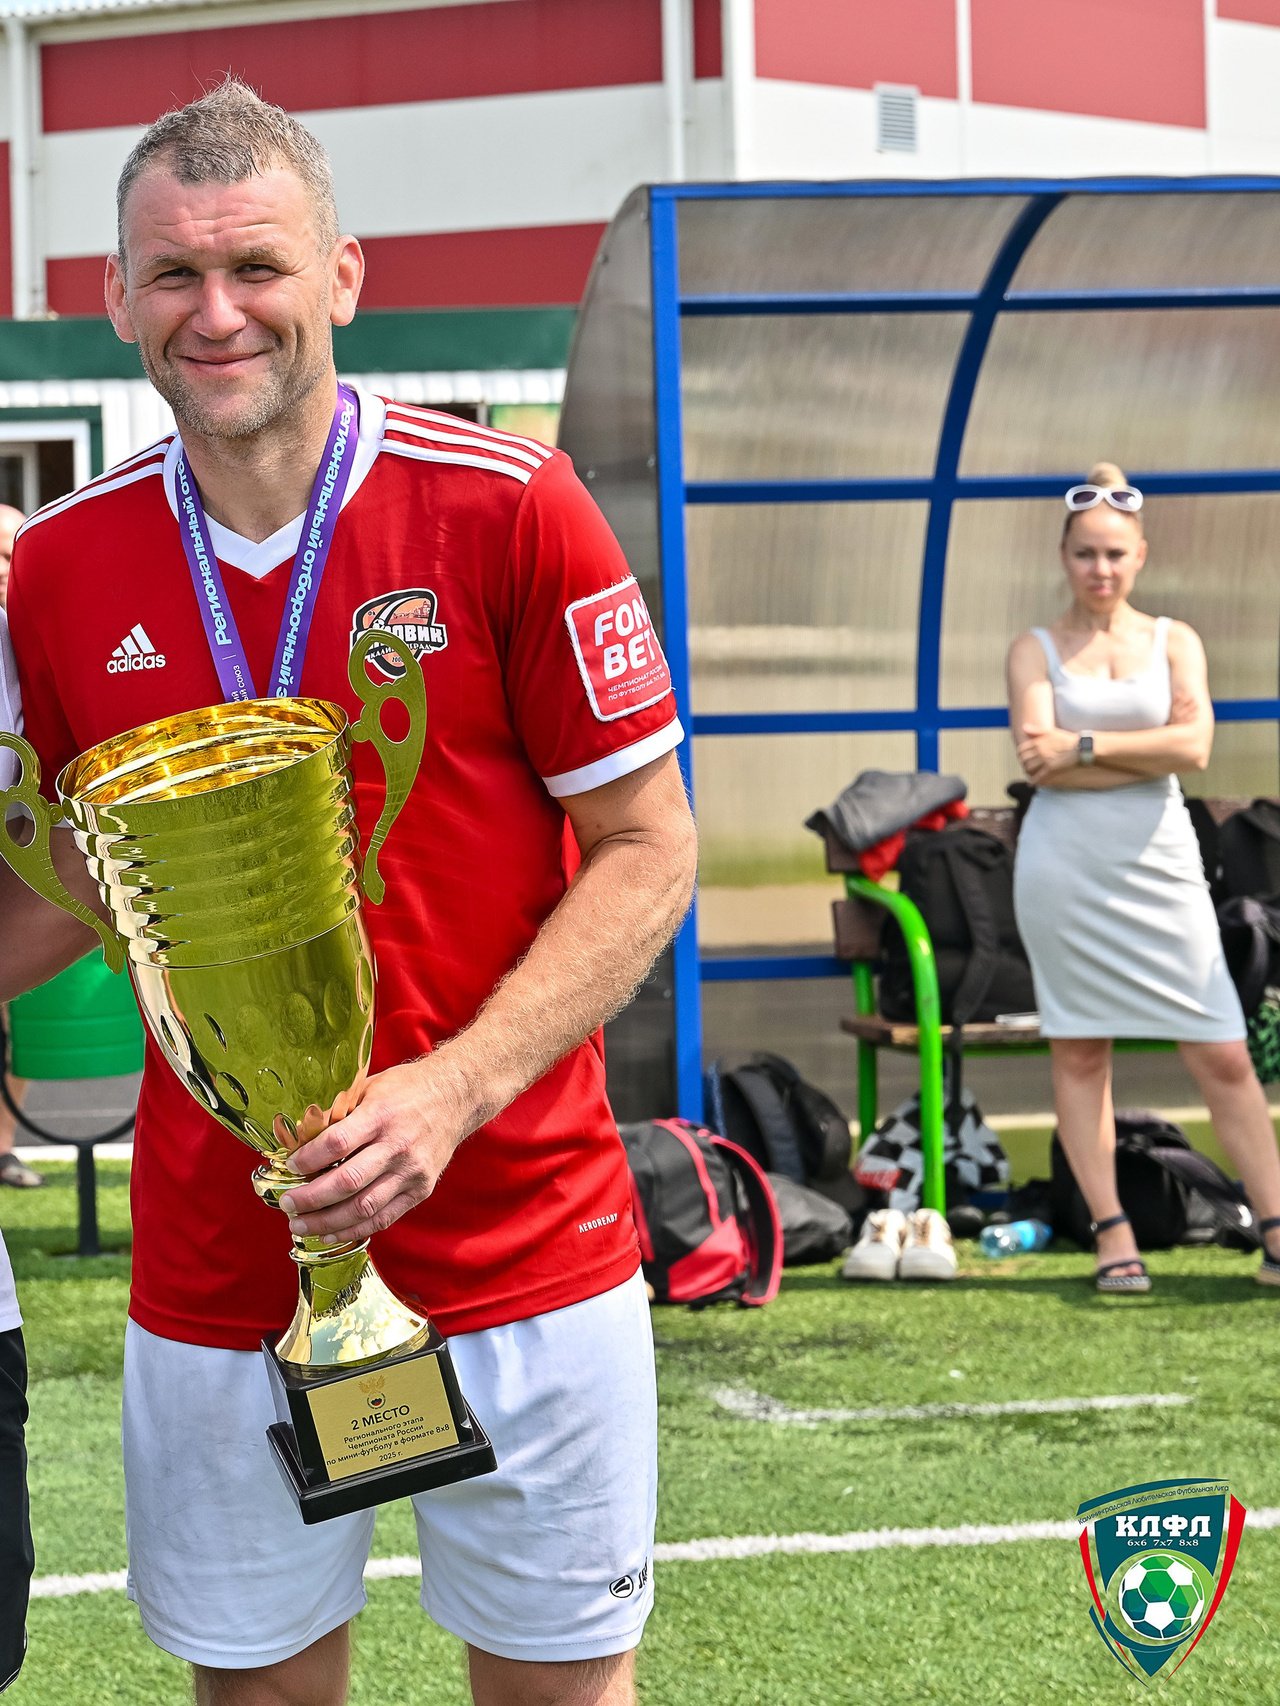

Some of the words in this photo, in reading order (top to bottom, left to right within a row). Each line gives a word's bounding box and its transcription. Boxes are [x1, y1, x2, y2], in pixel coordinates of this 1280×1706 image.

[307, 398, 355, 549] Региональный
[182, 495, 232, 646] Региональный
[278, 549, 316, 687] отборочный
[594, 598, 648, 647] FON
[107, 653, 166, 674] adidas
[604, 628, 656, 680] BET
[608, 673, 650, 692] ЧЕМПИОНАТ
[578, 1212, 618, 1234] AEROREADY
[343, 1423, 402, 1444] Регионального
[402, 1416, 424, 1427] этапа
[351, 1419, 360, 1431] 2
[362, 1404, 410, 1428] МЕСТО
[326, 1458, 337, 1466] по
[337, 1443, 393, 1463] мини-футболу
[400, 1429, 435, 1445] формате
[347, 1433, 396, 1450] Чемпионата
[396, 1424, 424, 1437] России
[378, 1451, 397, 1462] 2025
